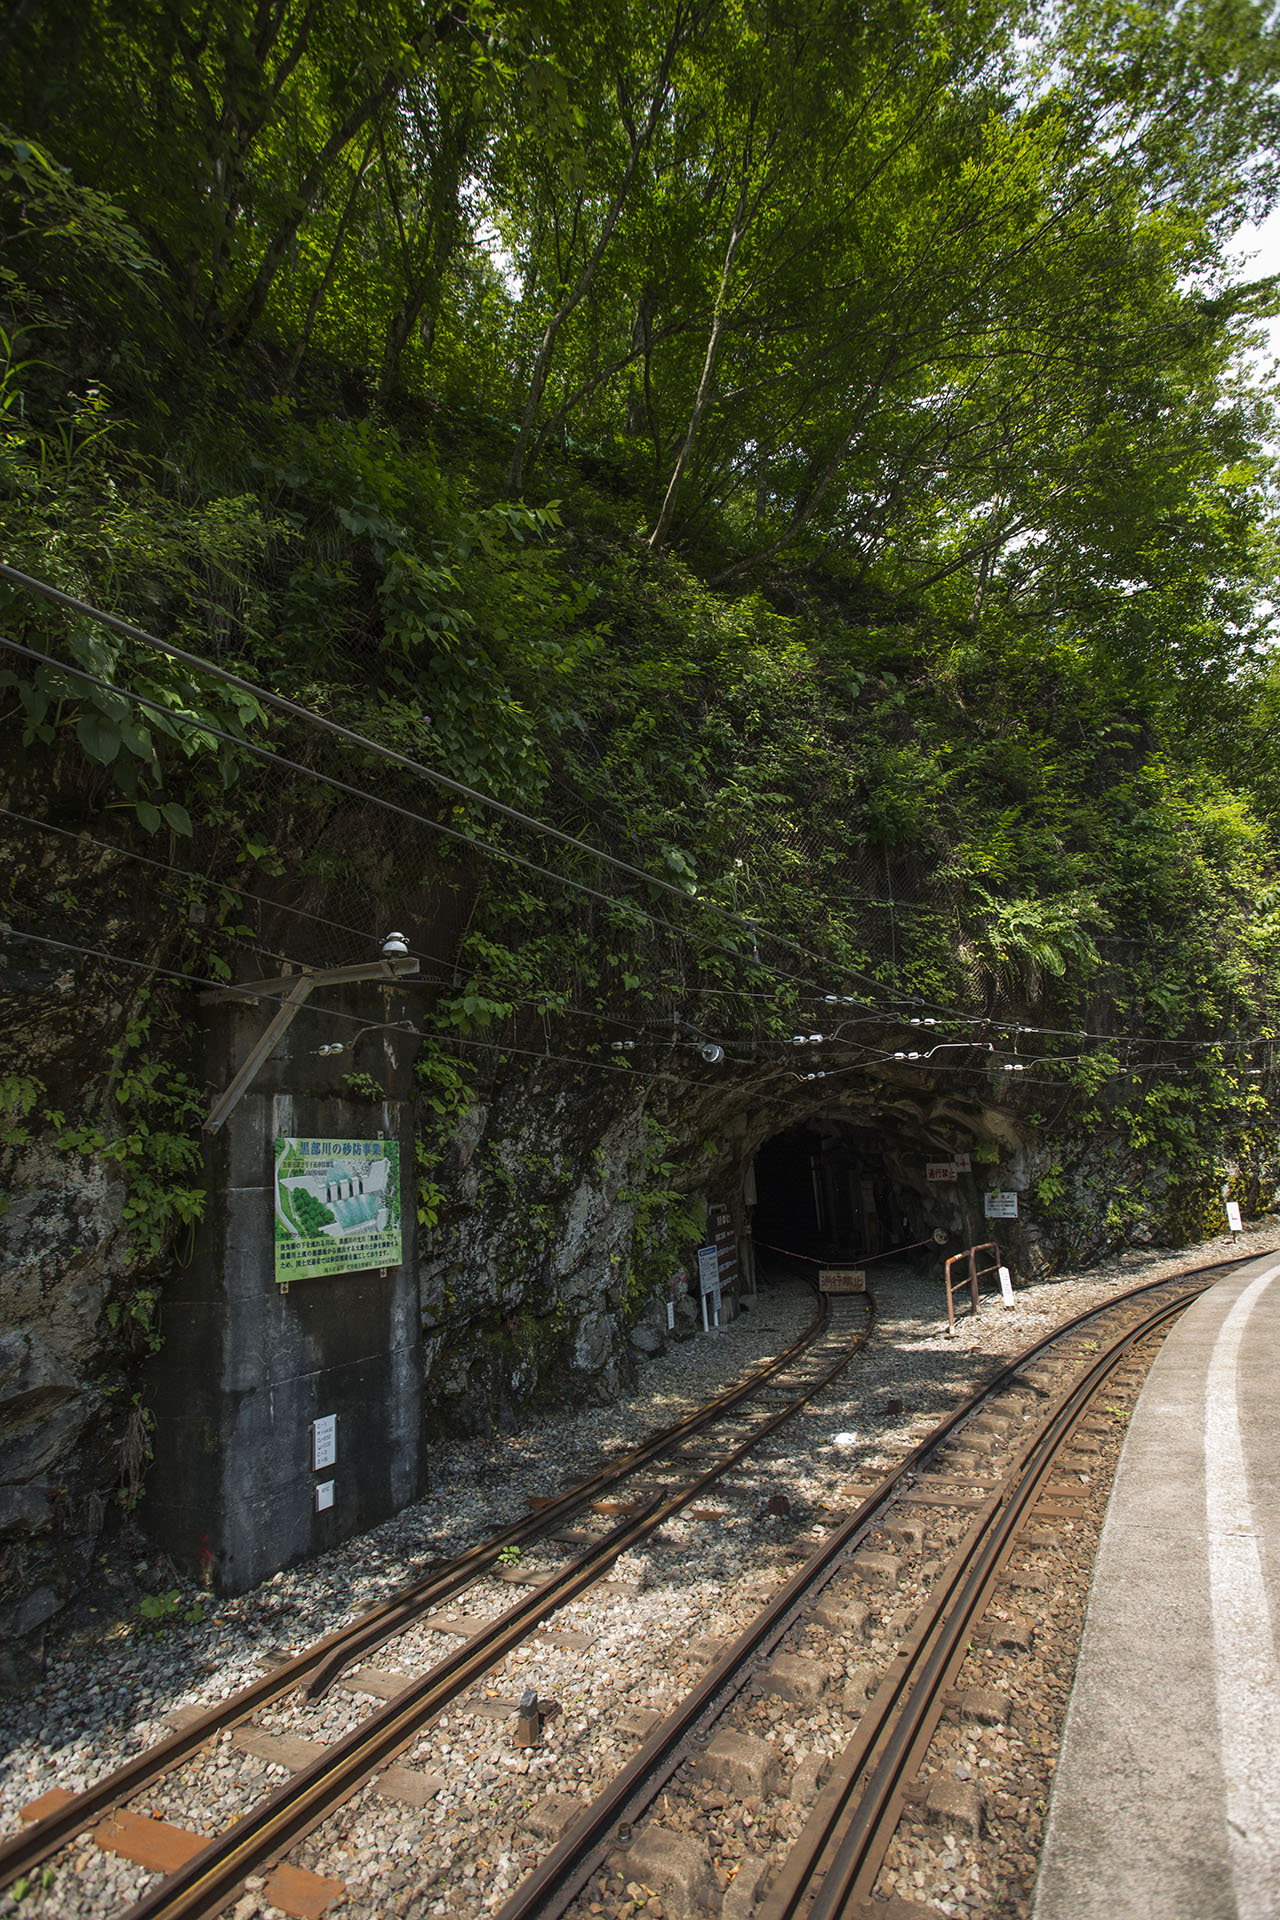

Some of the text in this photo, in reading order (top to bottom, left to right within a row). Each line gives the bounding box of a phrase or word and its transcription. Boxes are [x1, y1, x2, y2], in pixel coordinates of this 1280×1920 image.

[300, 1141, 381, 1156] 黒部川の砂防事業
[928, 1168, 957, 1178] 通行禁止
[821, 1274, 864, 1288] 通行禁止
